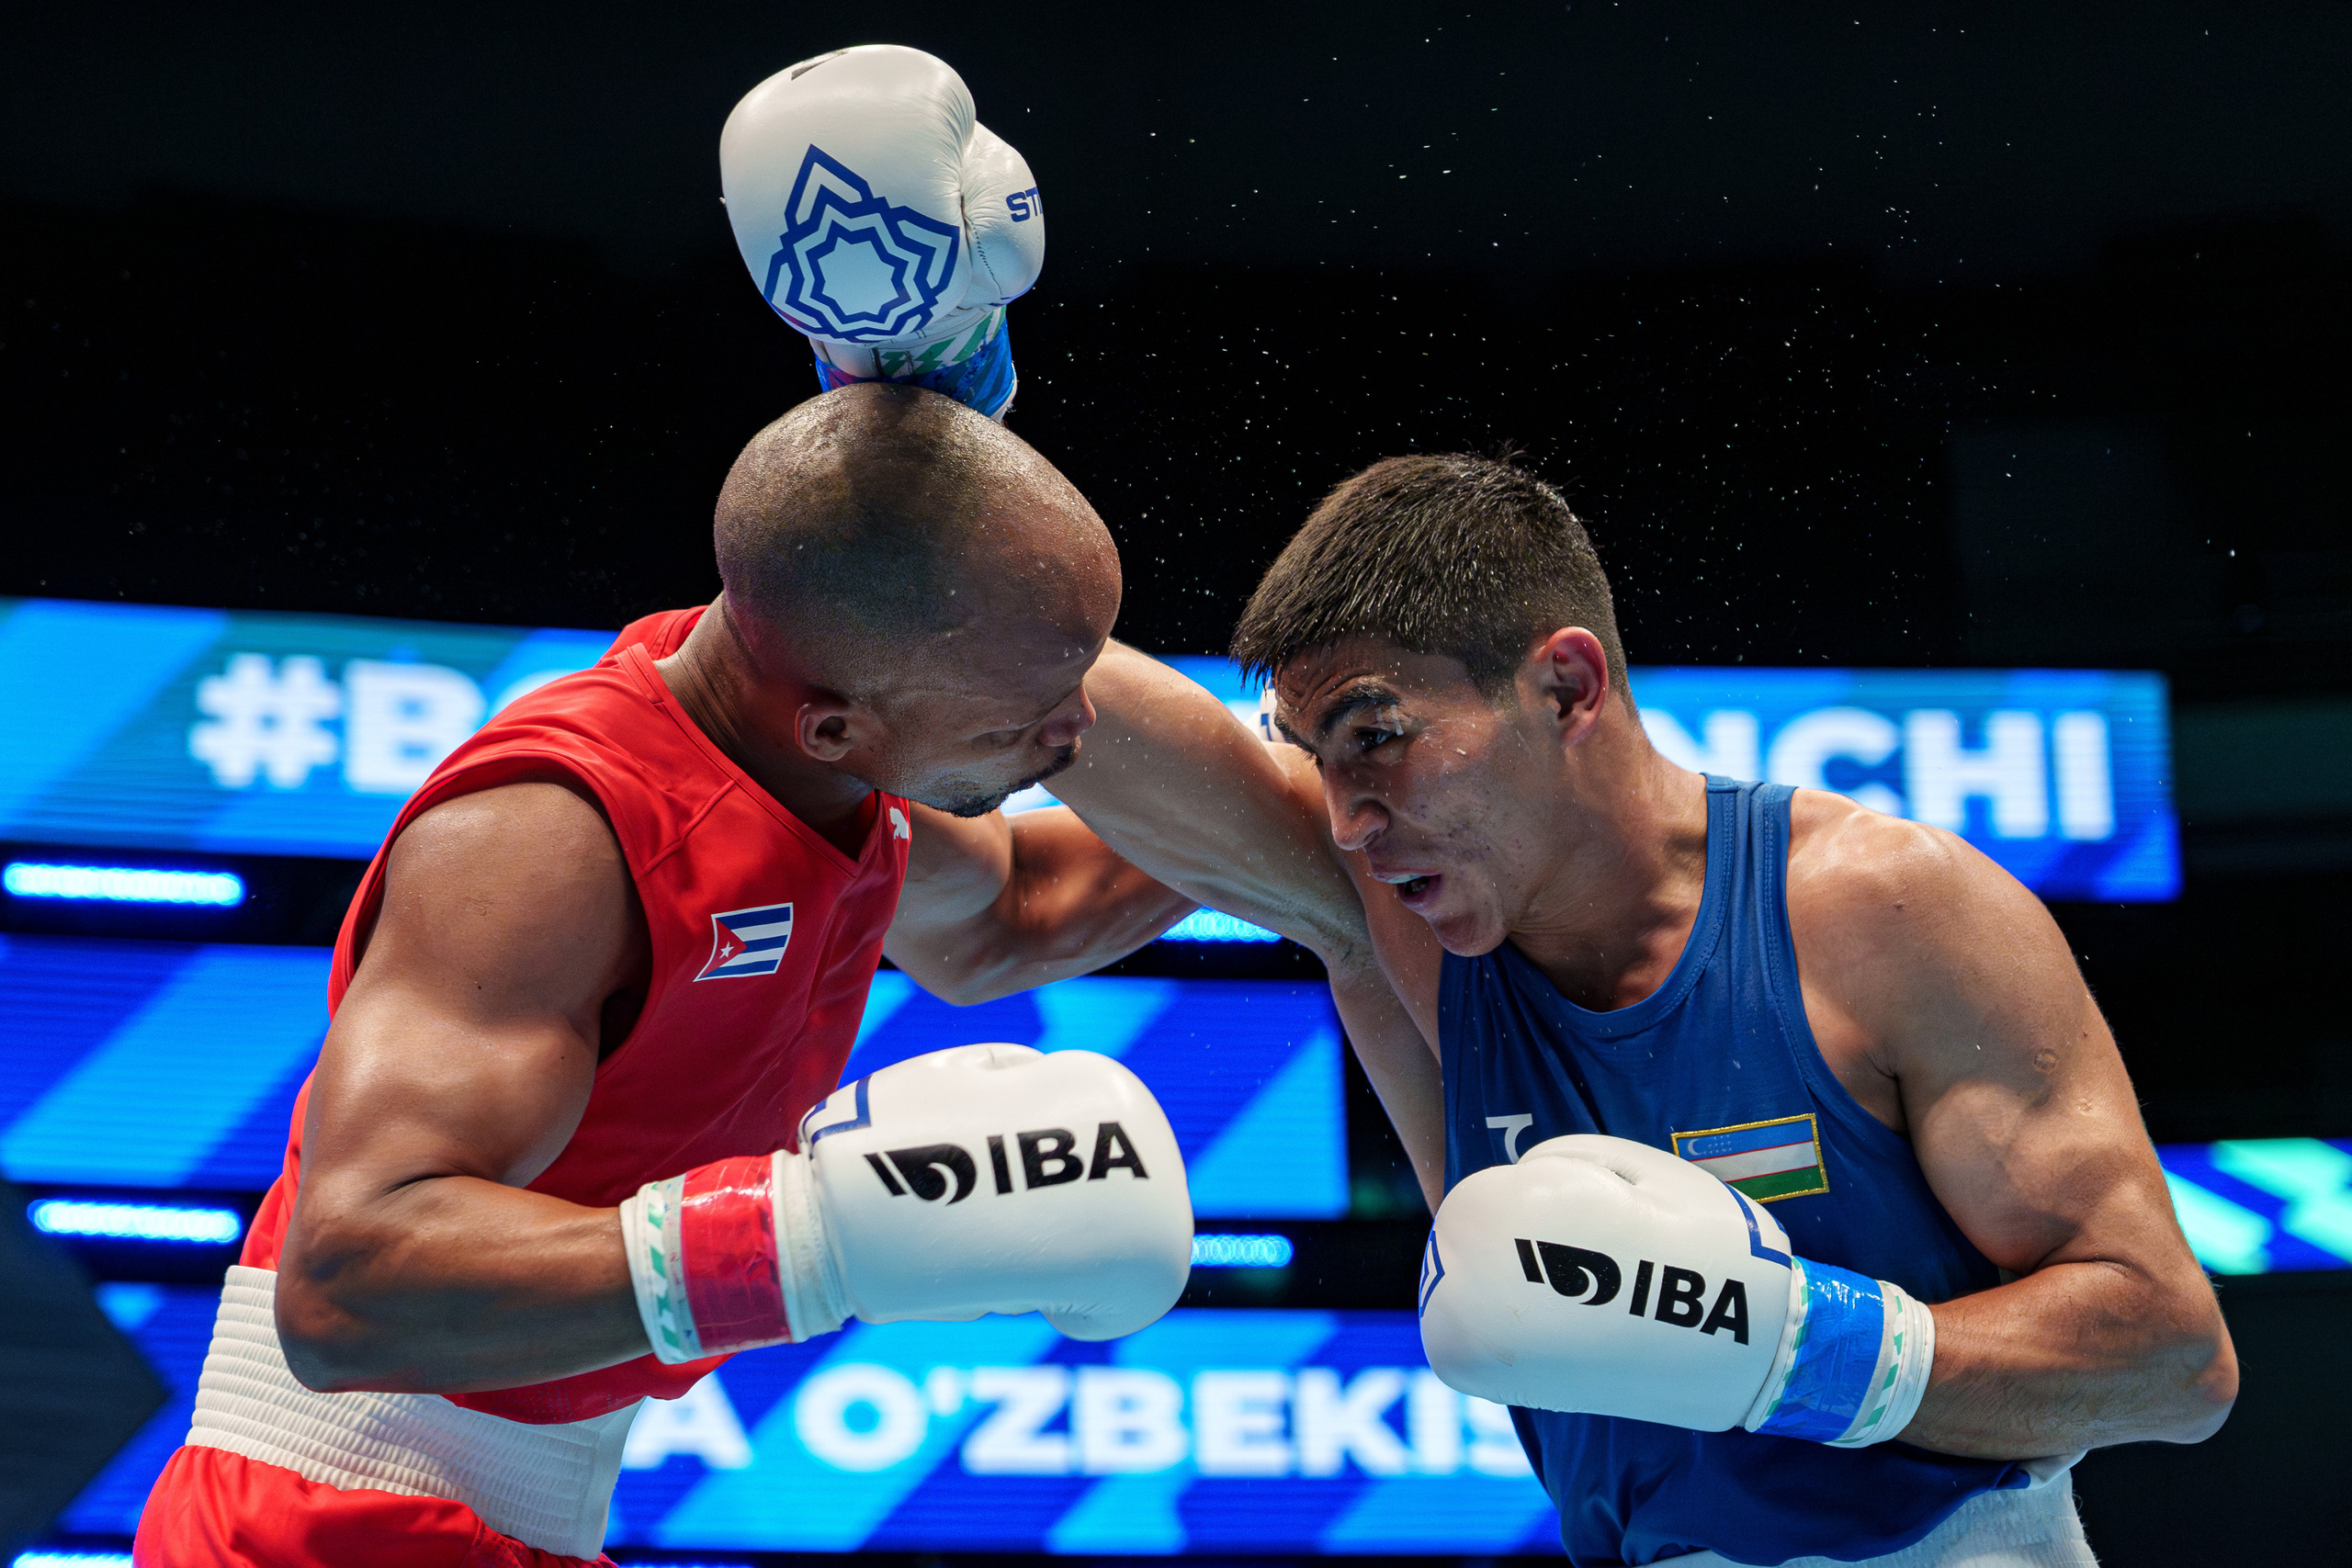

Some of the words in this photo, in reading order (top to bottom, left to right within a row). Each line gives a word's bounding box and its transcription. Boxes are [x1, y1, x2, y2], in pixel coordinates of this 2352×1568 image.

[1005, 186, 1043, 223] ST
[188, 650, 593, 795] #B
[986, 1121, 1149, 1197] IBA
[1629, 1258, 1749, 1347] IBA
